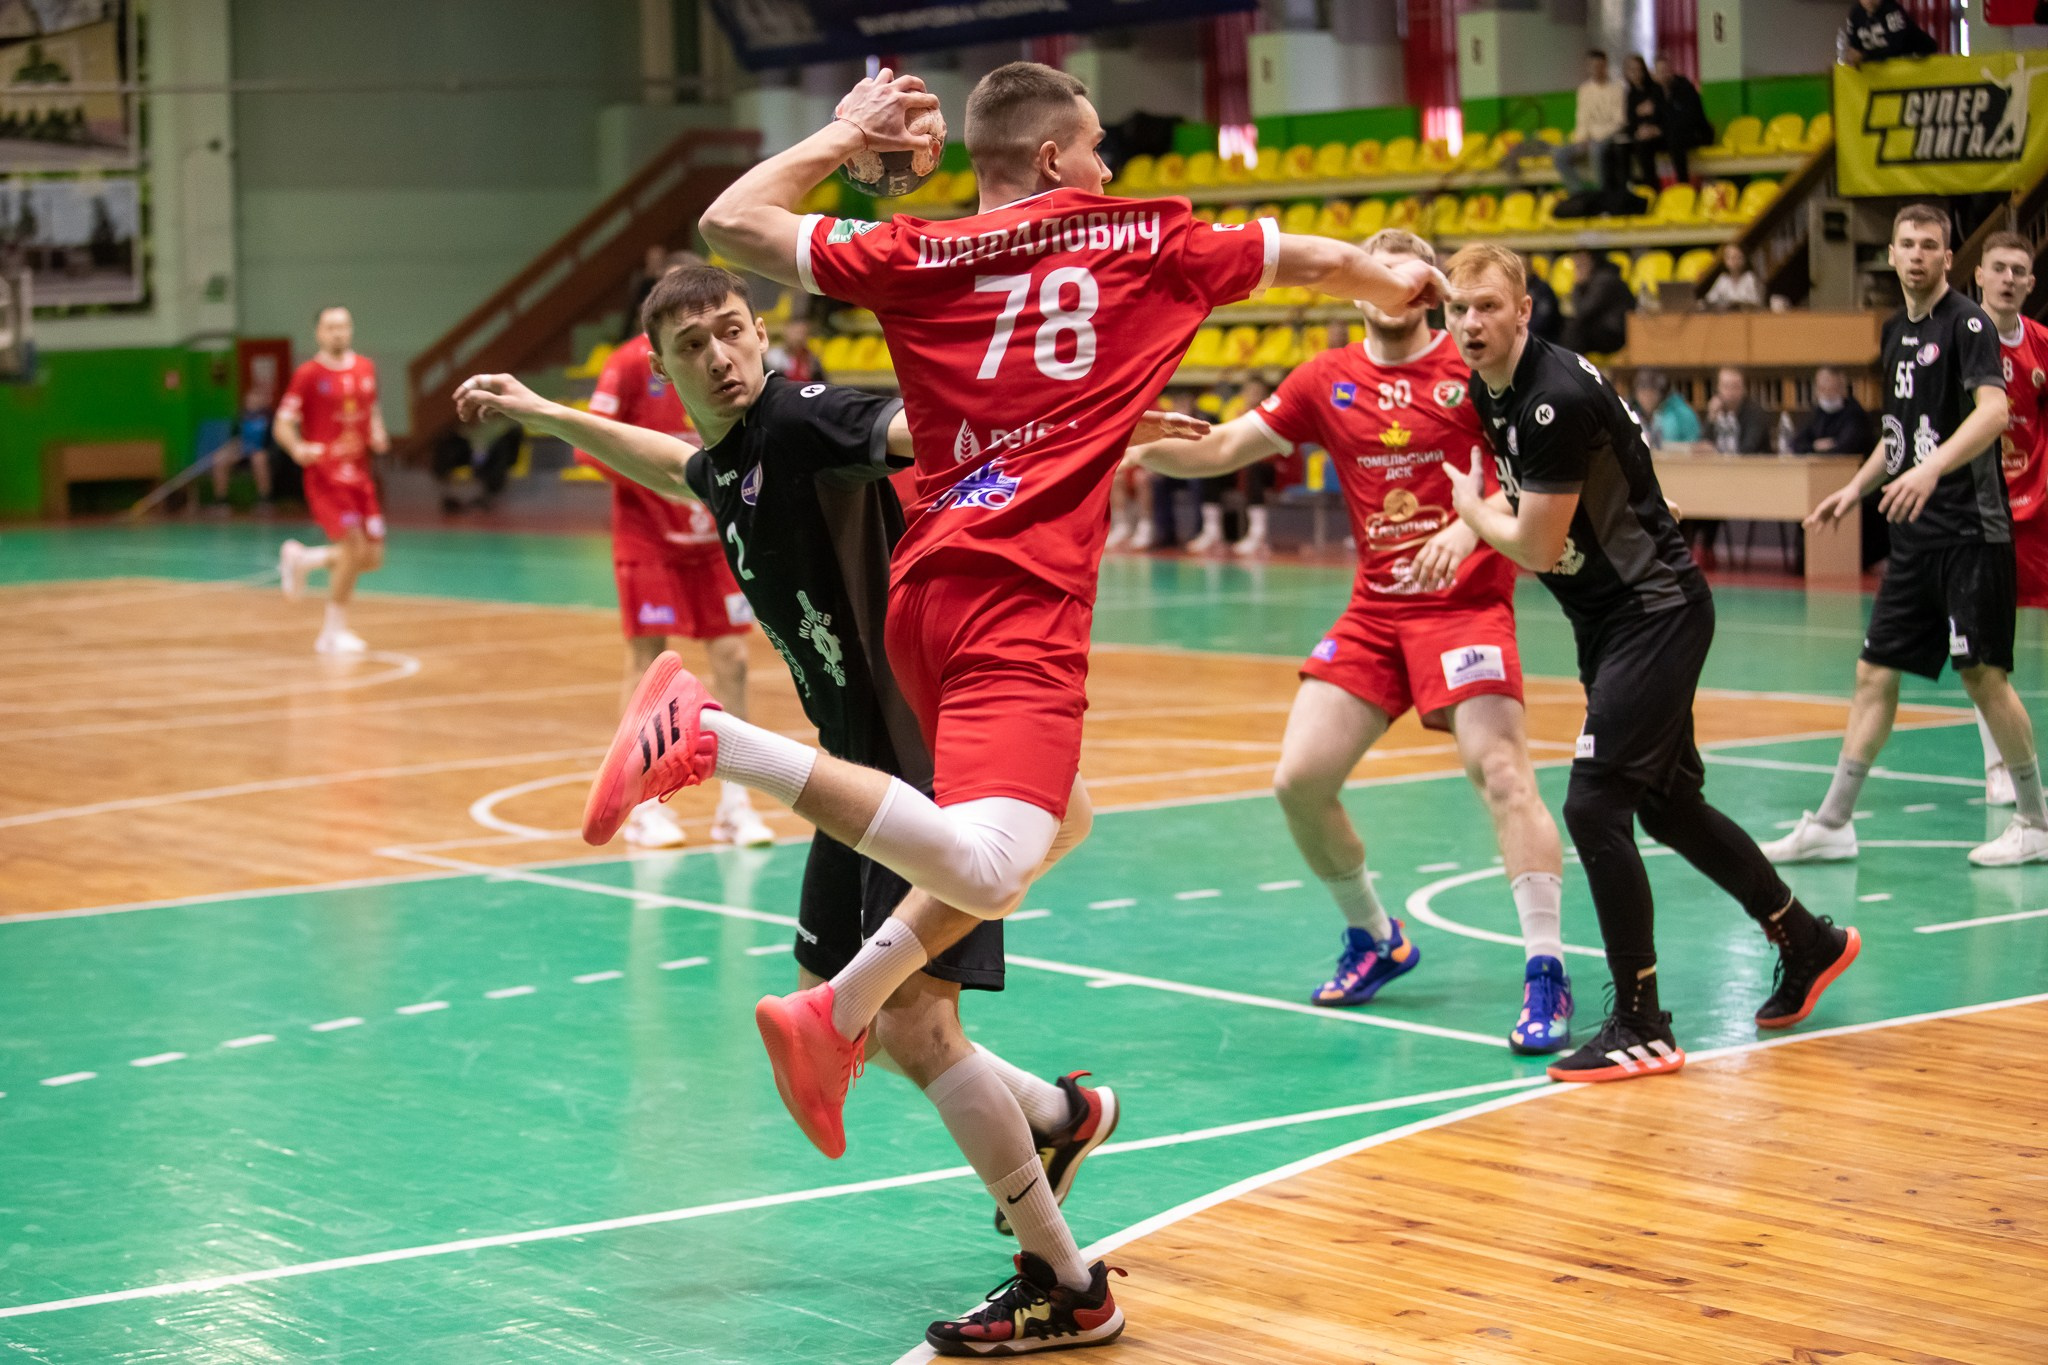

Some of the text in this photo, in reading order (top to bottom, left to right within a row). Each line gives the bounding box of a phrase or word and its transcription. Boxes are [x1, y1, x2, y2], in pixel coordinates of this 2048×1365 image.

[1903, 87, 1990, 127] СУПЕР
[1914, 124, 1985, 160] ЛИГА
[916, 211, 1161, 268] ШАФАЛОВИЧ
[974, 266, 1099, 381] 78
[1378, 379, 1412, 411] 30
[1894, 360, 1915, 399] 55
[726, 521, 755, 581] 2
